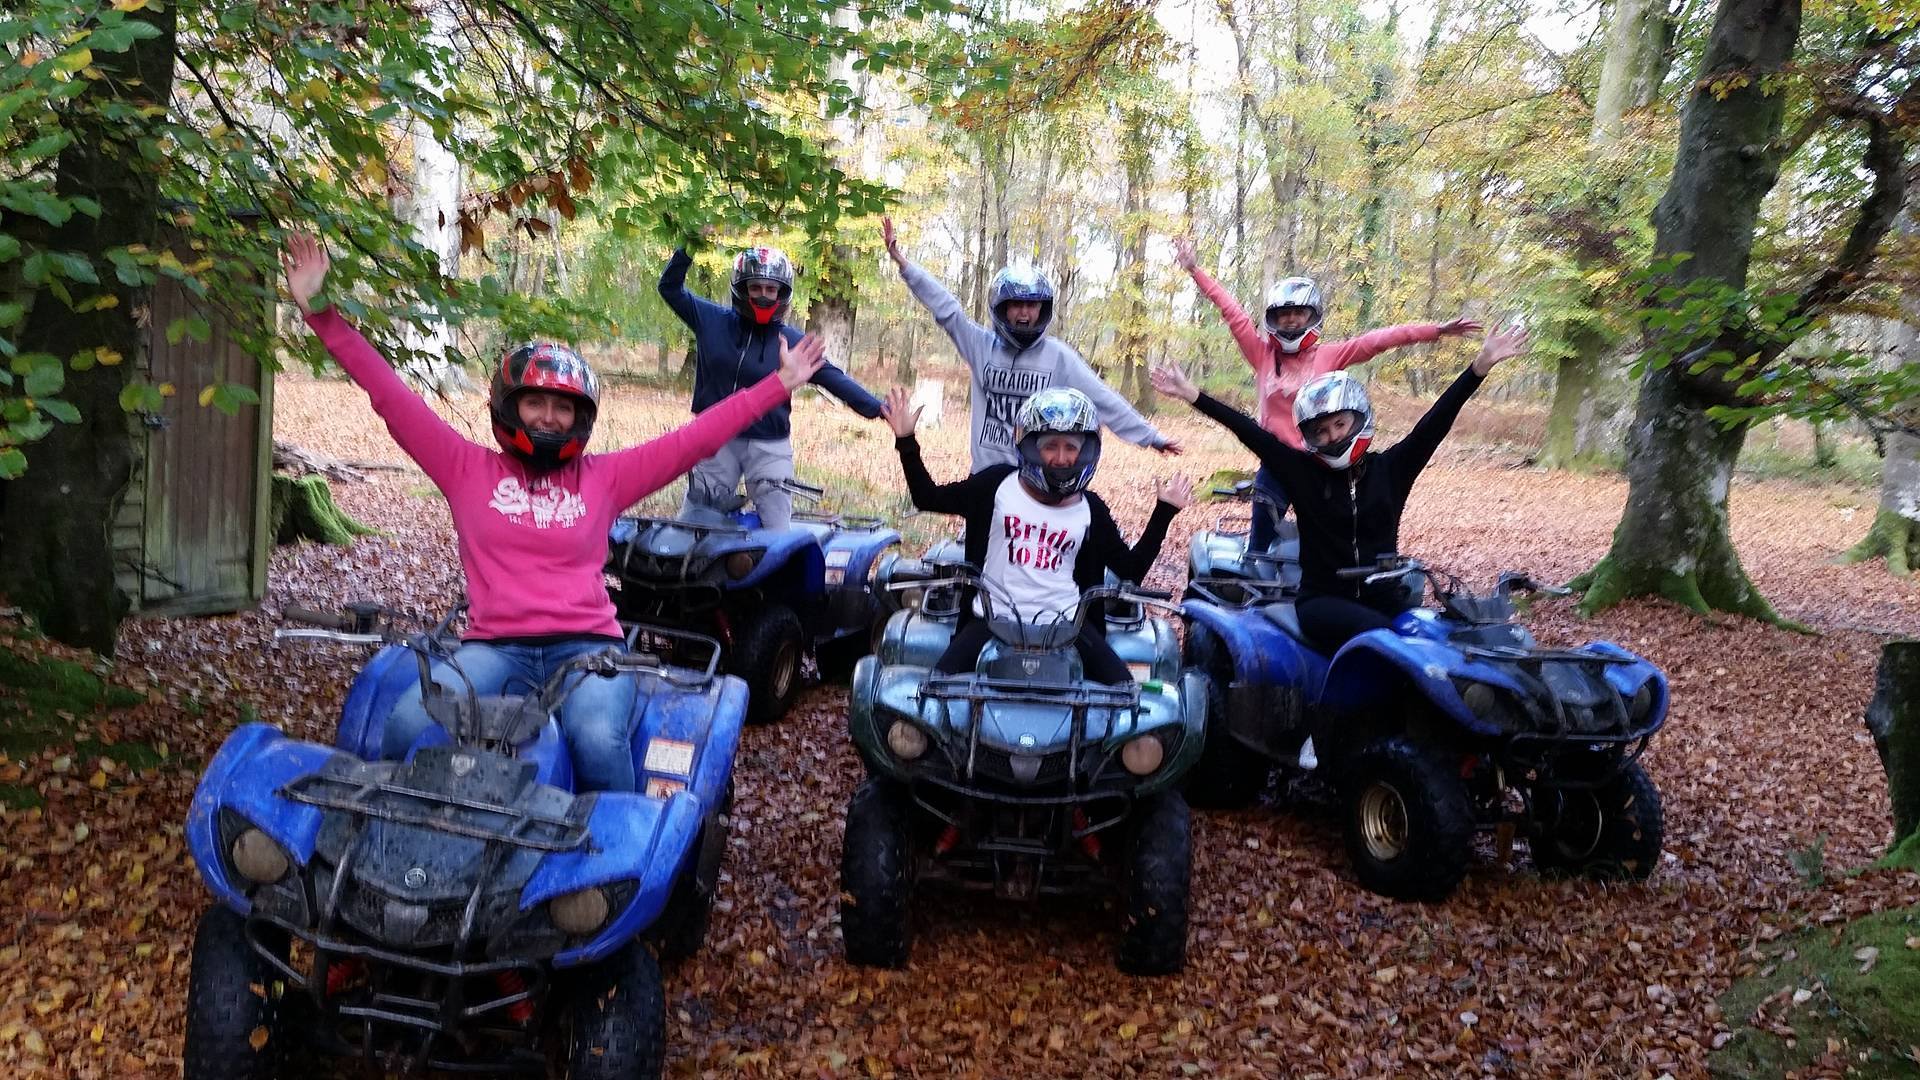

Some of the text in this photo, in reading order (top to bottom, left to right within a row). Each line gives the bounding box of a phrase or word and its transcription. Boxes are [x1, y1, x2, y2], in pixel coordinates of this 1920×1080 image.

[984, 366, 1047, 392] STRAIGHT
[1004, 515, 1076, 554] Bride
[1007, 538, 1063, 573] to Be
